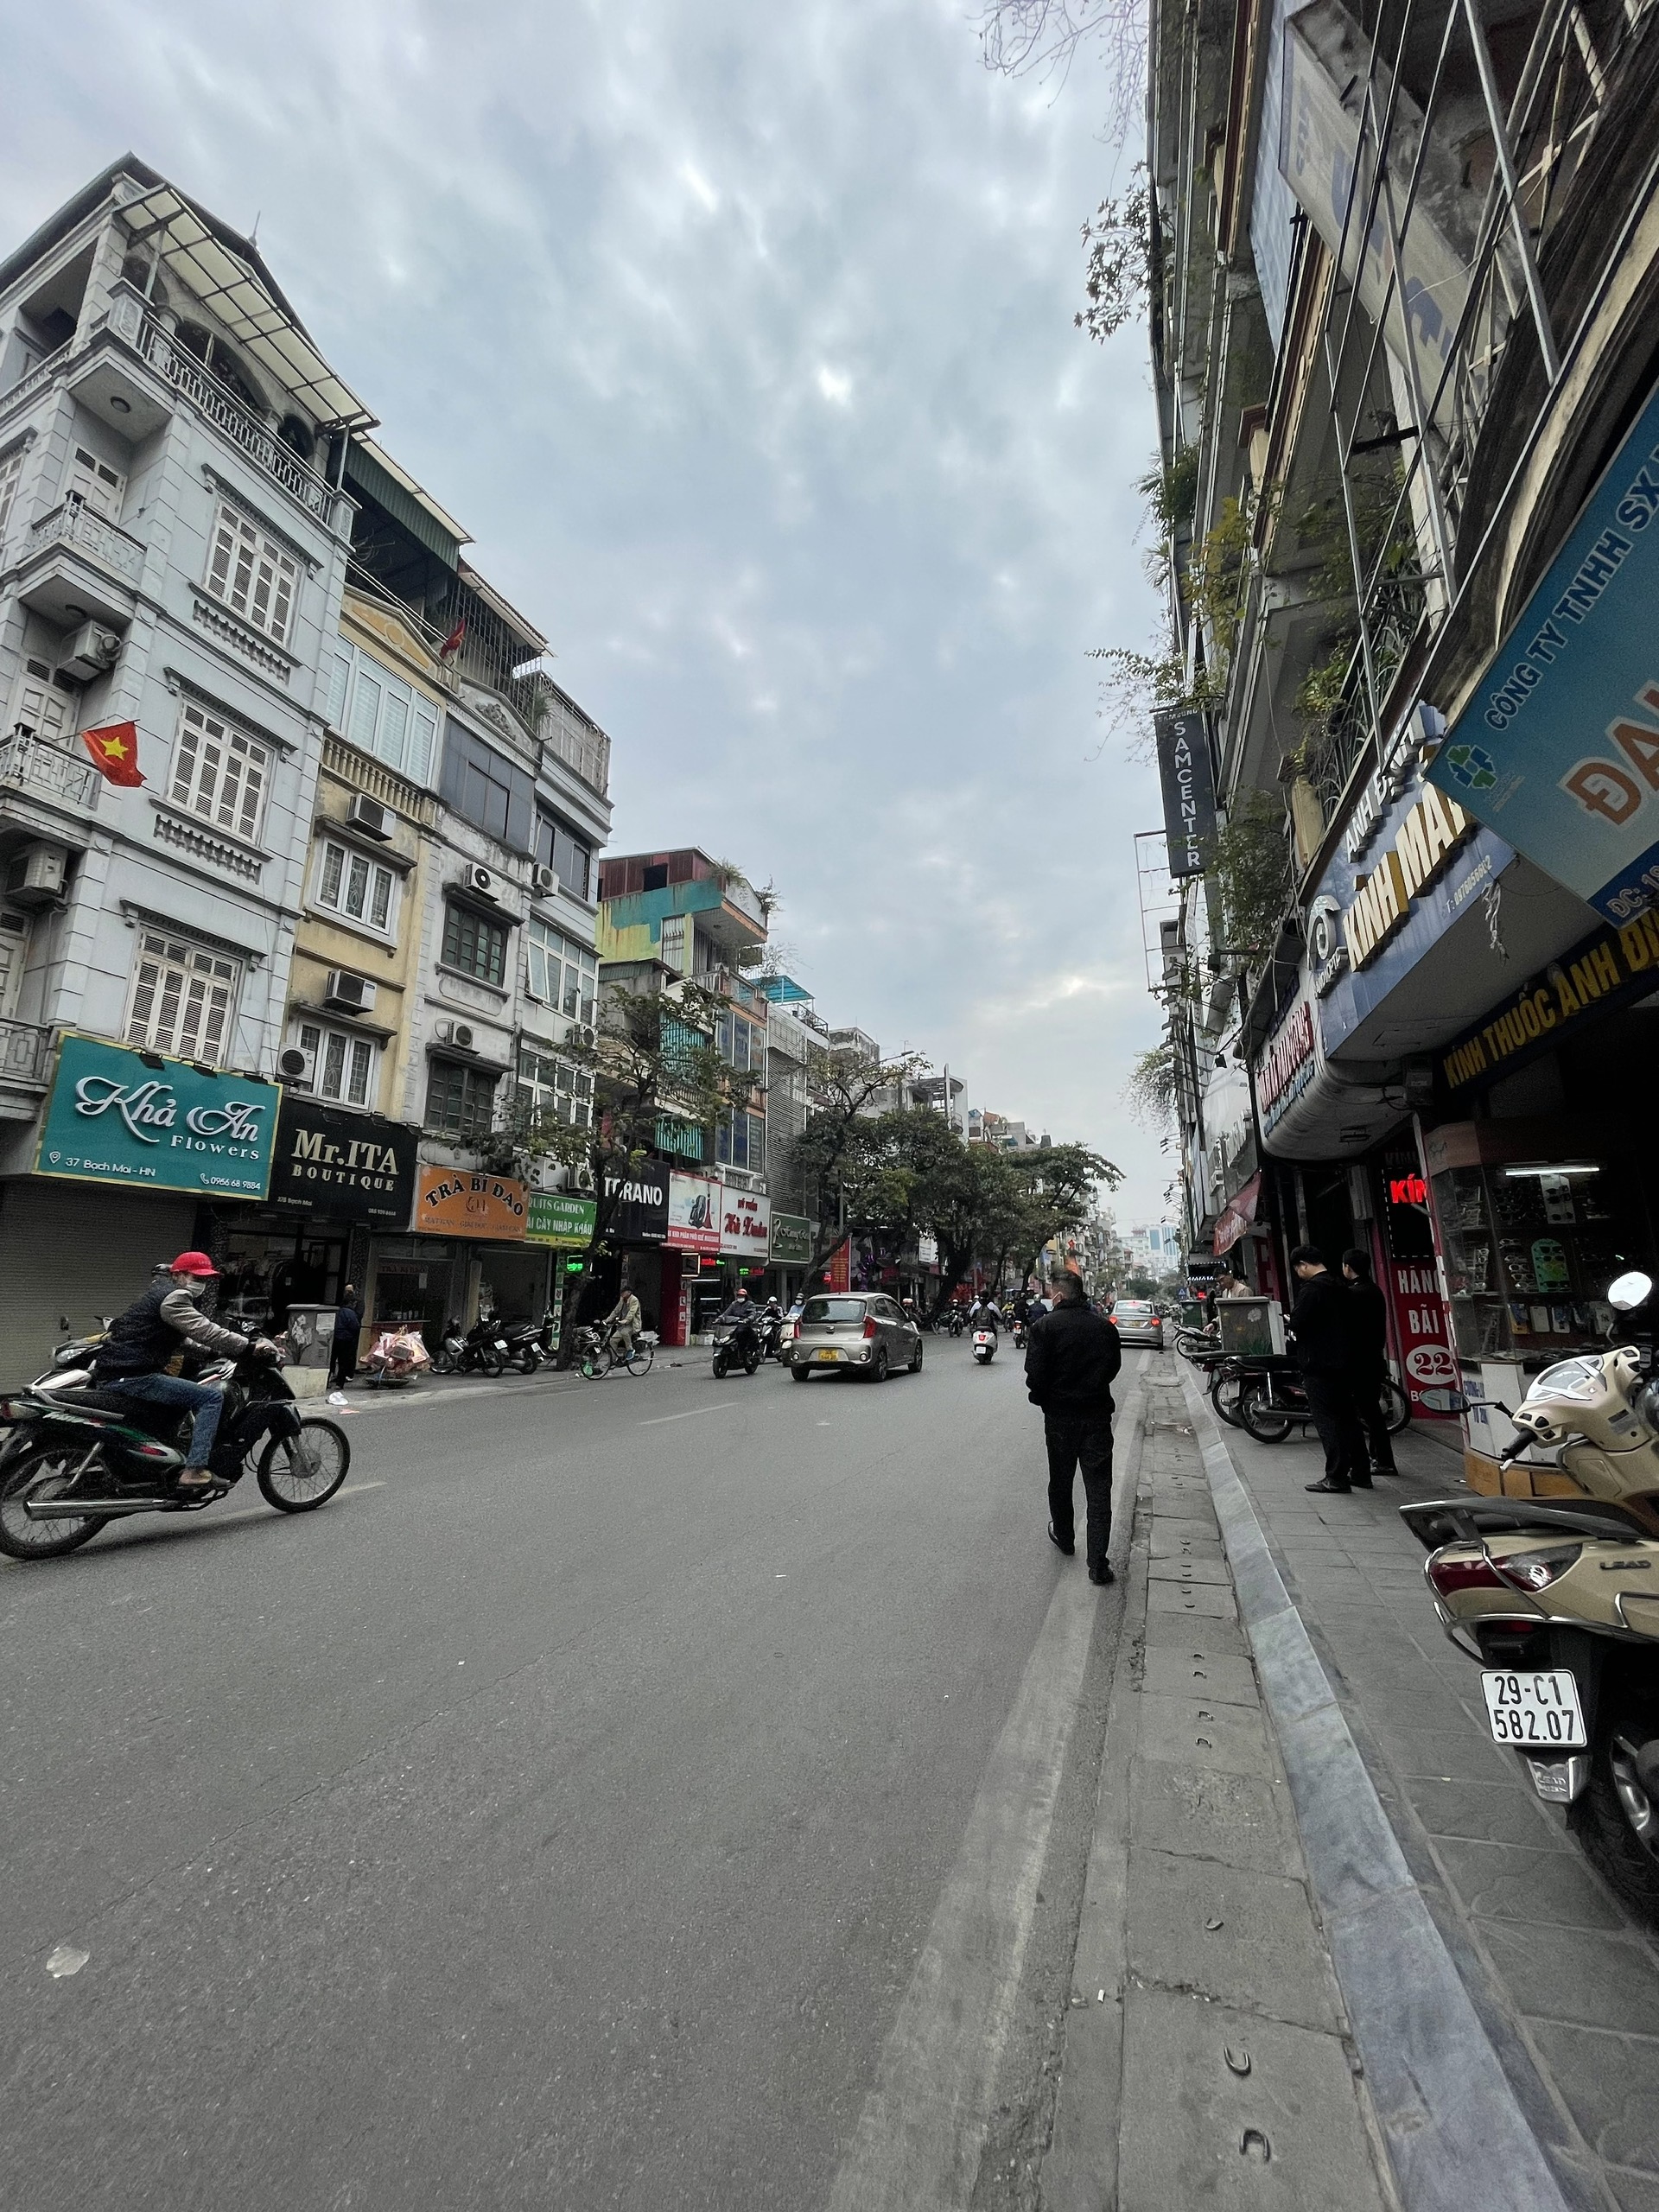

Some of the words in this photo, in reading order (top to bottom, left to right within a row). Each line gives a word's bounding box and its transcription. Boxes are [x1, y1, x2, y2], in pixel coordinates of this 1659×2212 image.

[1484, 663, 1543, 730] CÔNG
[1525, 618, 1568, 664] TY
[1553, 527, 1634, 625] TNHH
[1558, 680, 1659, 831] ĐA
[75, 1076, 175, 1143] Khả
[186, 1101, 266, 1142] An
[171, 1135, 260, 1160] Flowers
[291, 1128, 399, 1175] Mr.ITA
[65, 1156, 80, 1167] 37
[83, 1160, 110, 1172] Bạch
[112, 1163, 131, 1173] Mai
[139, 1166, 156, 1177] HN
[291, 1164, 395, 1192] BOUTIQUE
[424, 1173, 467, 1208] TRÀ
[536, 1216, 551, 1230] CÂY
[553, 1200, 585, 1215] GARDEN
[1408, 1303, 1440, 1334] BÃI
[1414, 1352, 1454, 1376] 22
[1599, 1560, 1652, 1570] LEAD
[1494, 1675, 1563, 1707] 29-C1
[1493, 1708, 1574, 1742] 582.07
